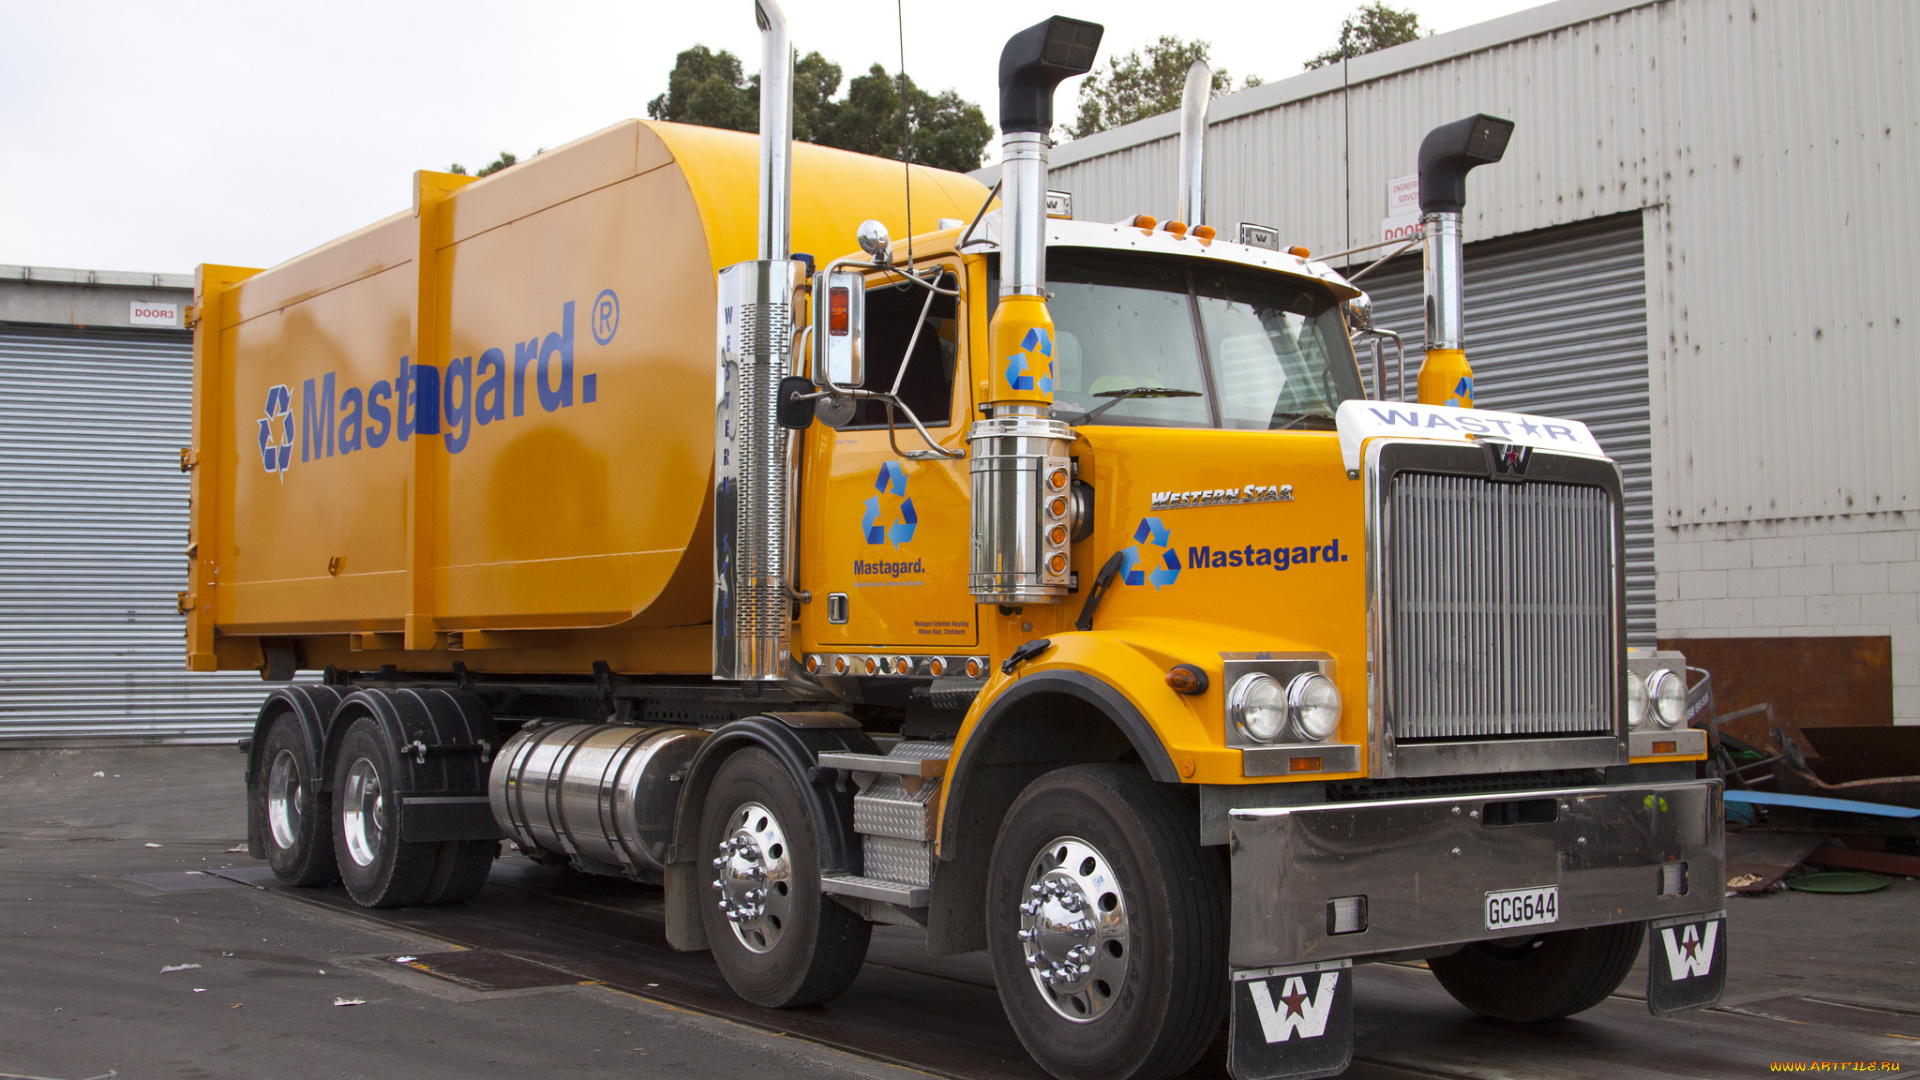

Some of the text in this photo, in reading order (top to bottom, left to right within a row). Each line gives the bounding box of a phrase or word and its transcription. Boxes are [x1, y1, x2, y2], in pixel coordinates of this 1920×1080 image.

[1255, 233, 1267, 243] W
[135, 308, 175, 319] DOOR3
[301, 299, 597, 464] Mastagard.
[1150, 483, 1294, 510] WESTERN STAR
[853, 557, 926, 578] Mastagard.
[1188, 538, 1348, 571] Mastagard.
[1489, 892, 1556, 925] GCG644
